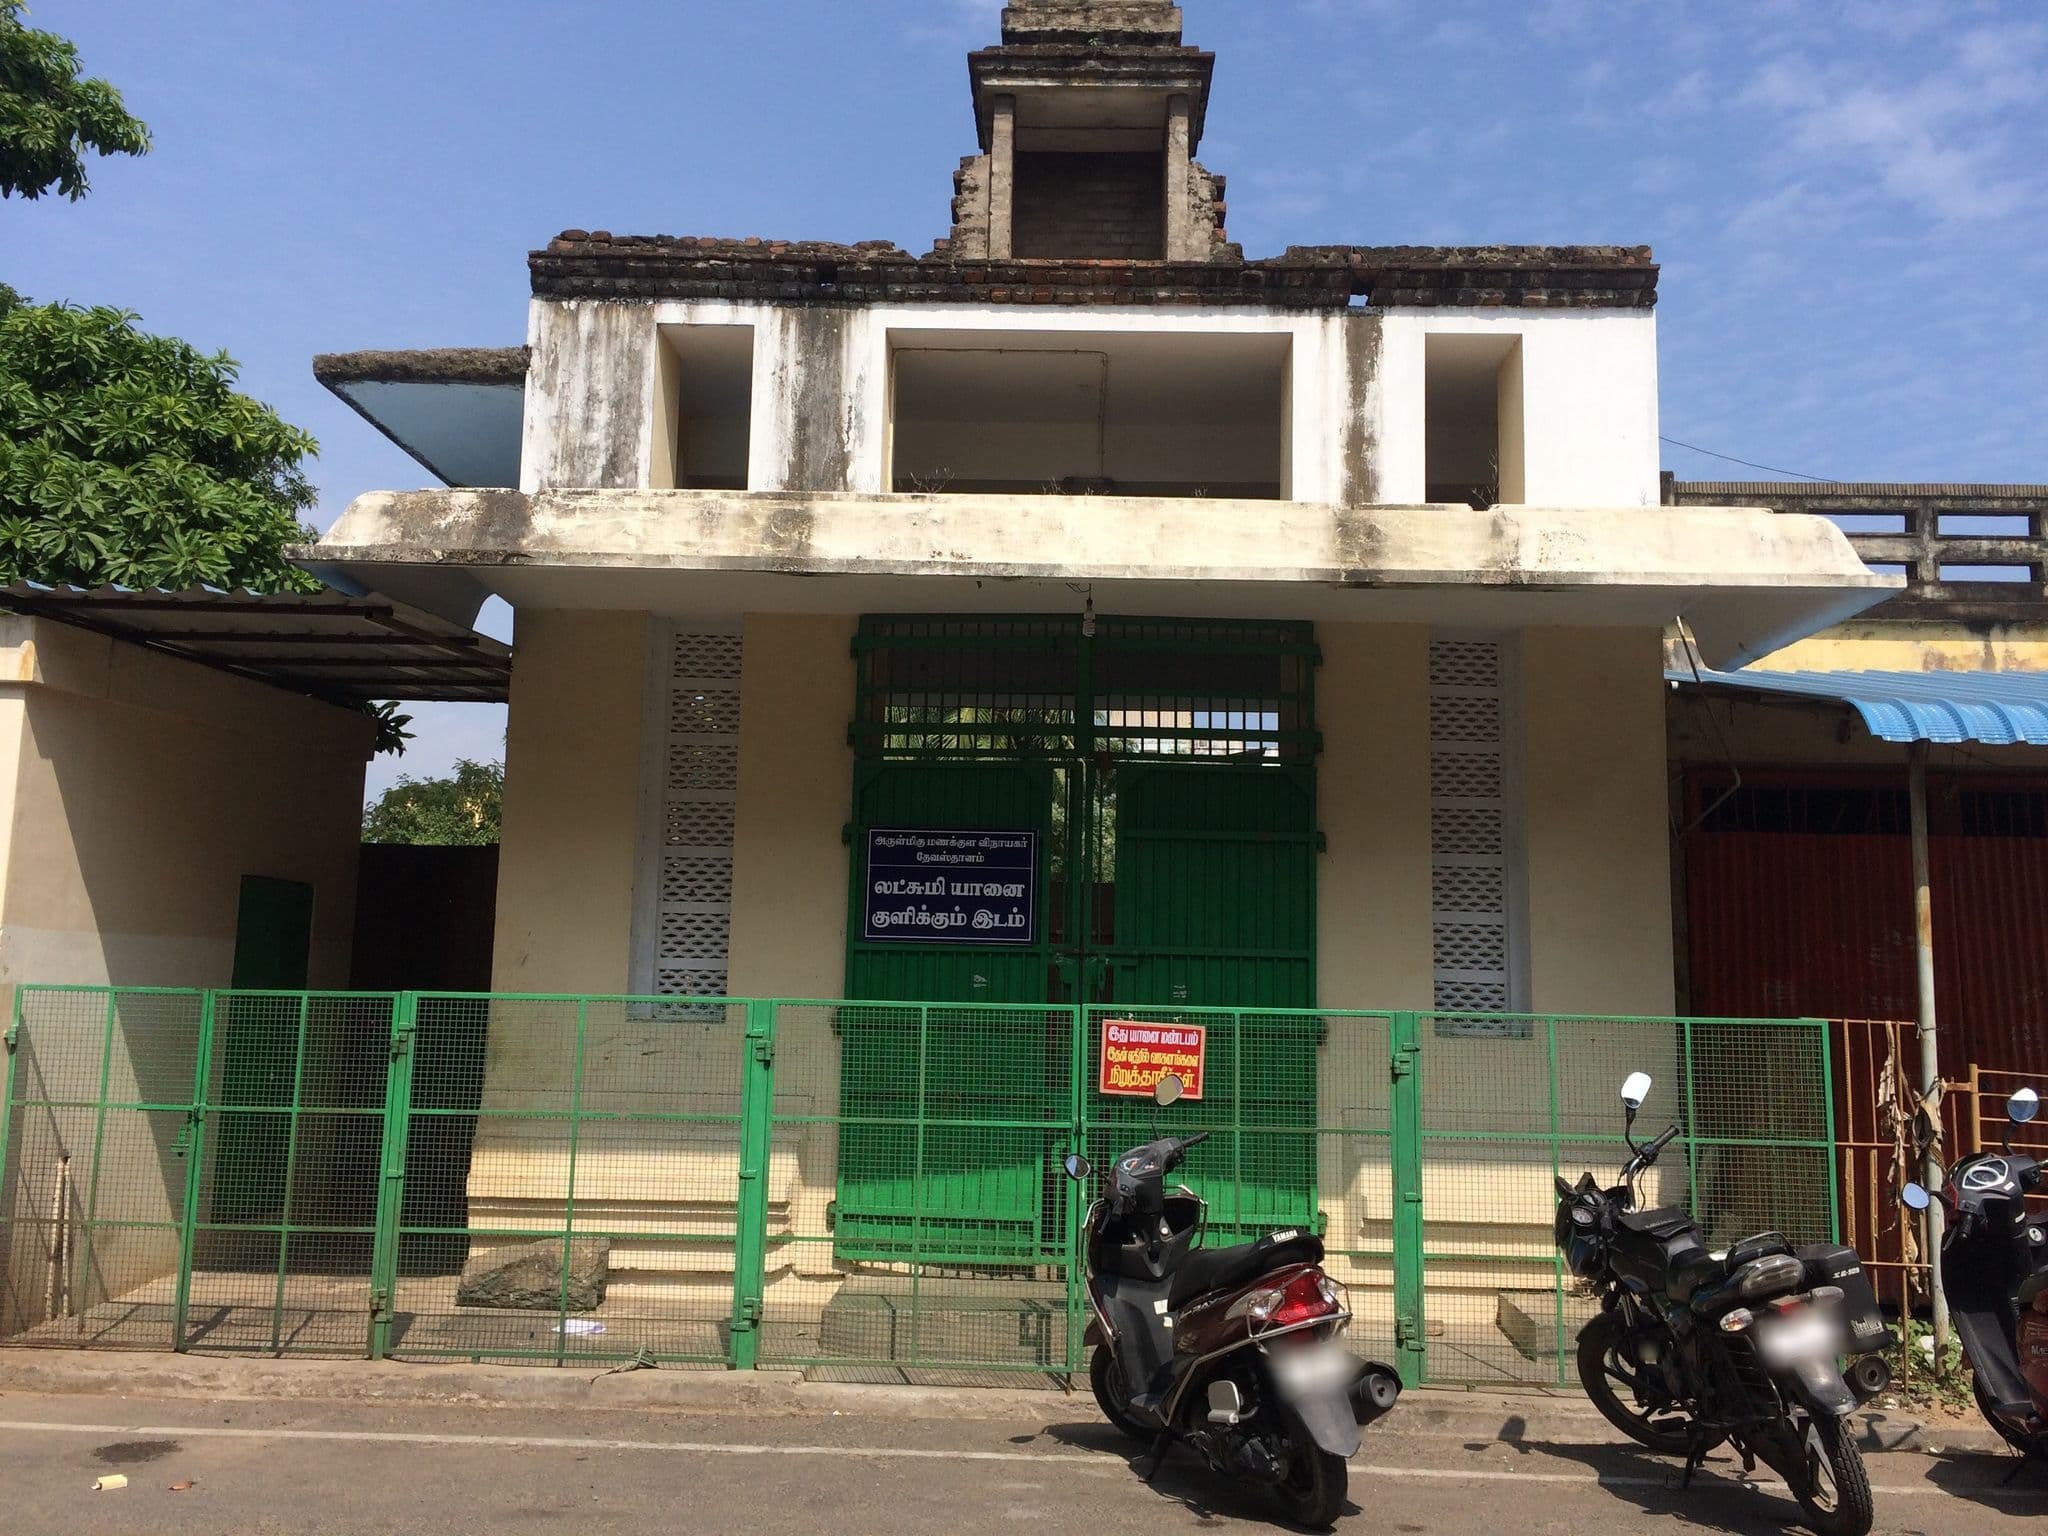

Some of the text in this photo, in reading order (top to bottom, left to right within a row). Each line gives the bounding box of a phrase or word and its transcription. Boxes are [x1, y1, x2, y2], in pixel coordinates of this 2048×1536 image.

[874, 834, 926, 848] அருள்மிகு
[978, 837, 1028, 850] விநாயகர்
[916, 850, 985, 864] தேவஸ்தானம்
[874, 876, 1025, 898] லட்சுமி யானை
[871, 904, 1025, 930] குளிக்கும் இடம்
[1108, 1025, 1129, 1043] இது
[1129, 1029, 1159, 1044] யானை
[1271, 1229, 1298, 1243] YAMAHA
